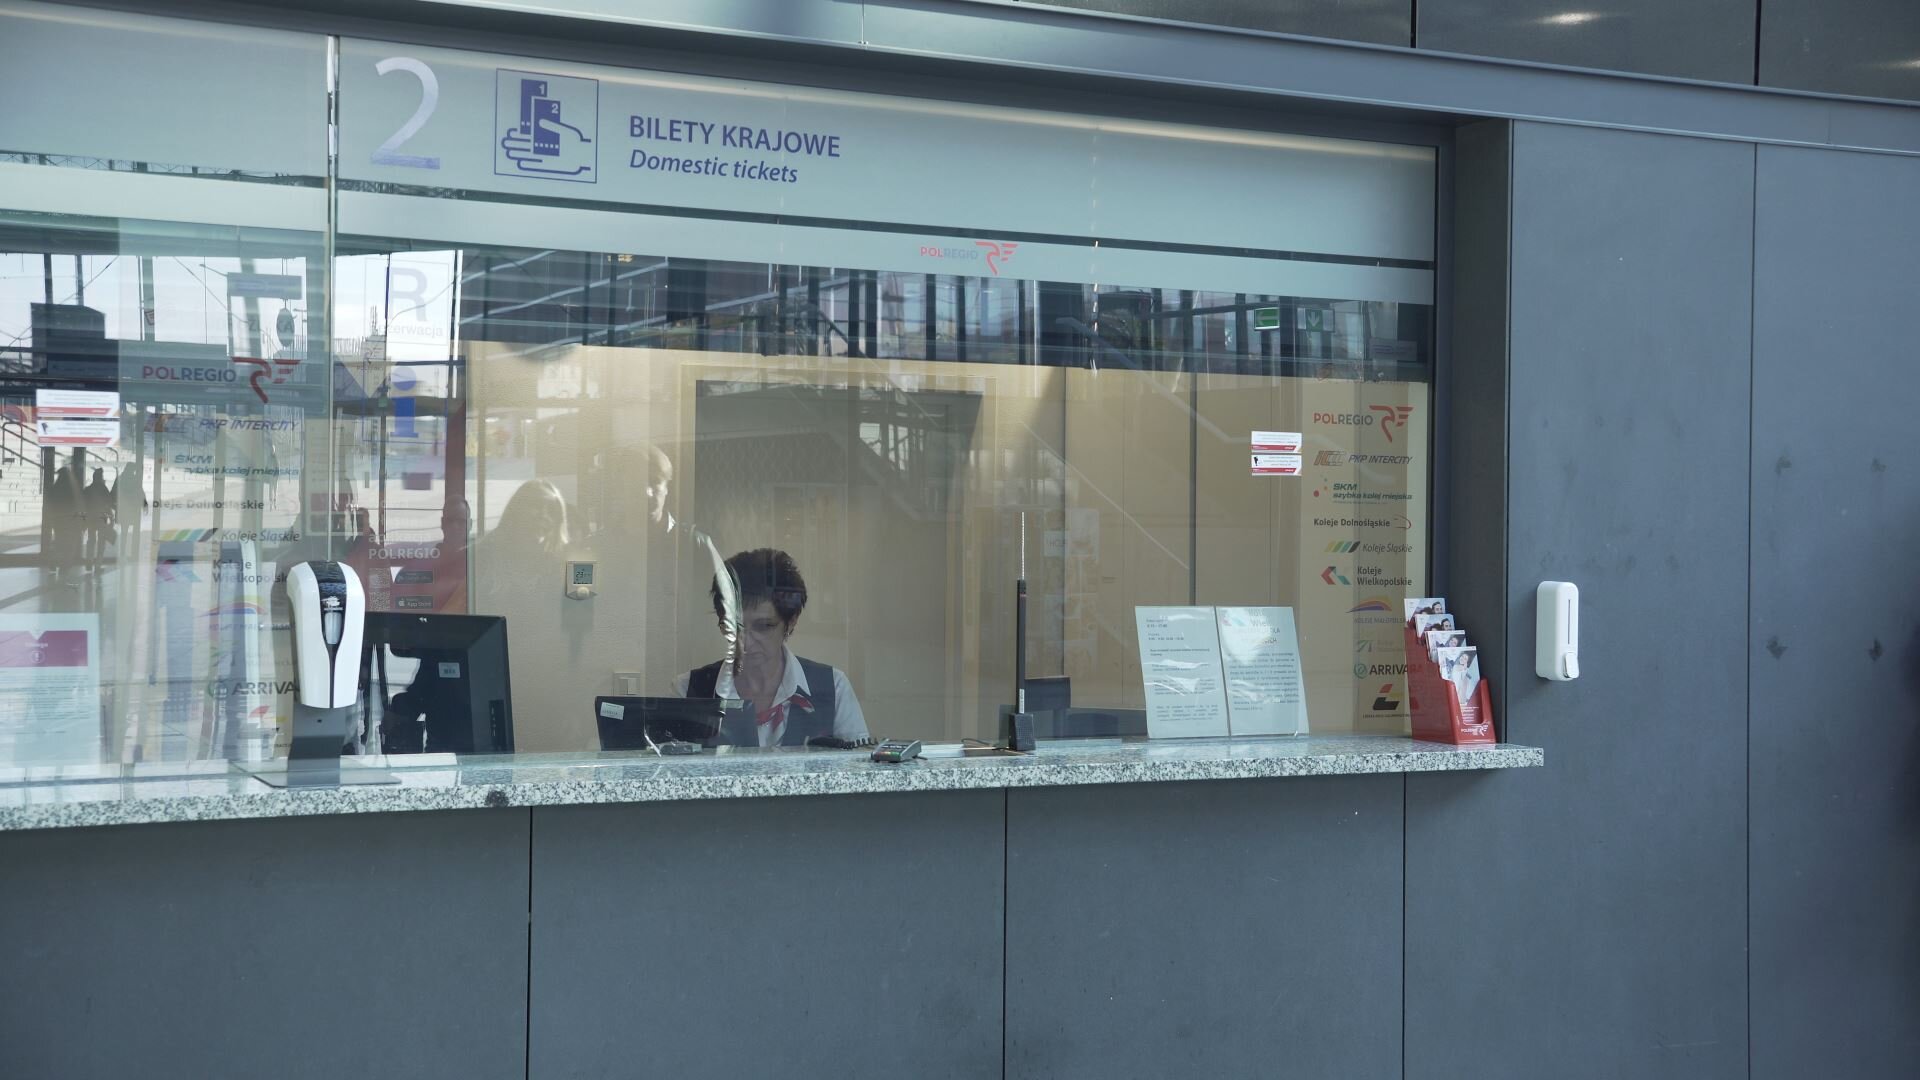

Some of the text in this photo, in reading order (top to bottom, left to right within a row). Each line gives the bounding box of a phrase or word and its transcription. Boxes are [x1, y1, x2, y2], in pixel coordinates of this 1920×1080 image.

[371, 57, 440, 169] 2
[629, 115, 841, 158] BILETY KRAJOWE
[629, 149, 798, 183] Domestic tickets
[920, 246, 978, 260] POLREGIO
[142, 366, 237, 382] POLREGIO
[231, 419, 299, 431] INTERCITY
[1313, 412, 1374, 426] POLREGIO
[1348, 454, 1413, 465] PKP INTERCITY
[1333, 483, 1358, 491] SKM
[1314, 518, 1338, 527] Koleje
[221, 531, 257, 543] Koleje
[368, 547, 441, 560] POLREGIO
[1362, 543, 1385, 554] Koleje
[1357, 566, 1382, 576] Koleje
[1357, 576, 1413, 587] Wielkopolskie
